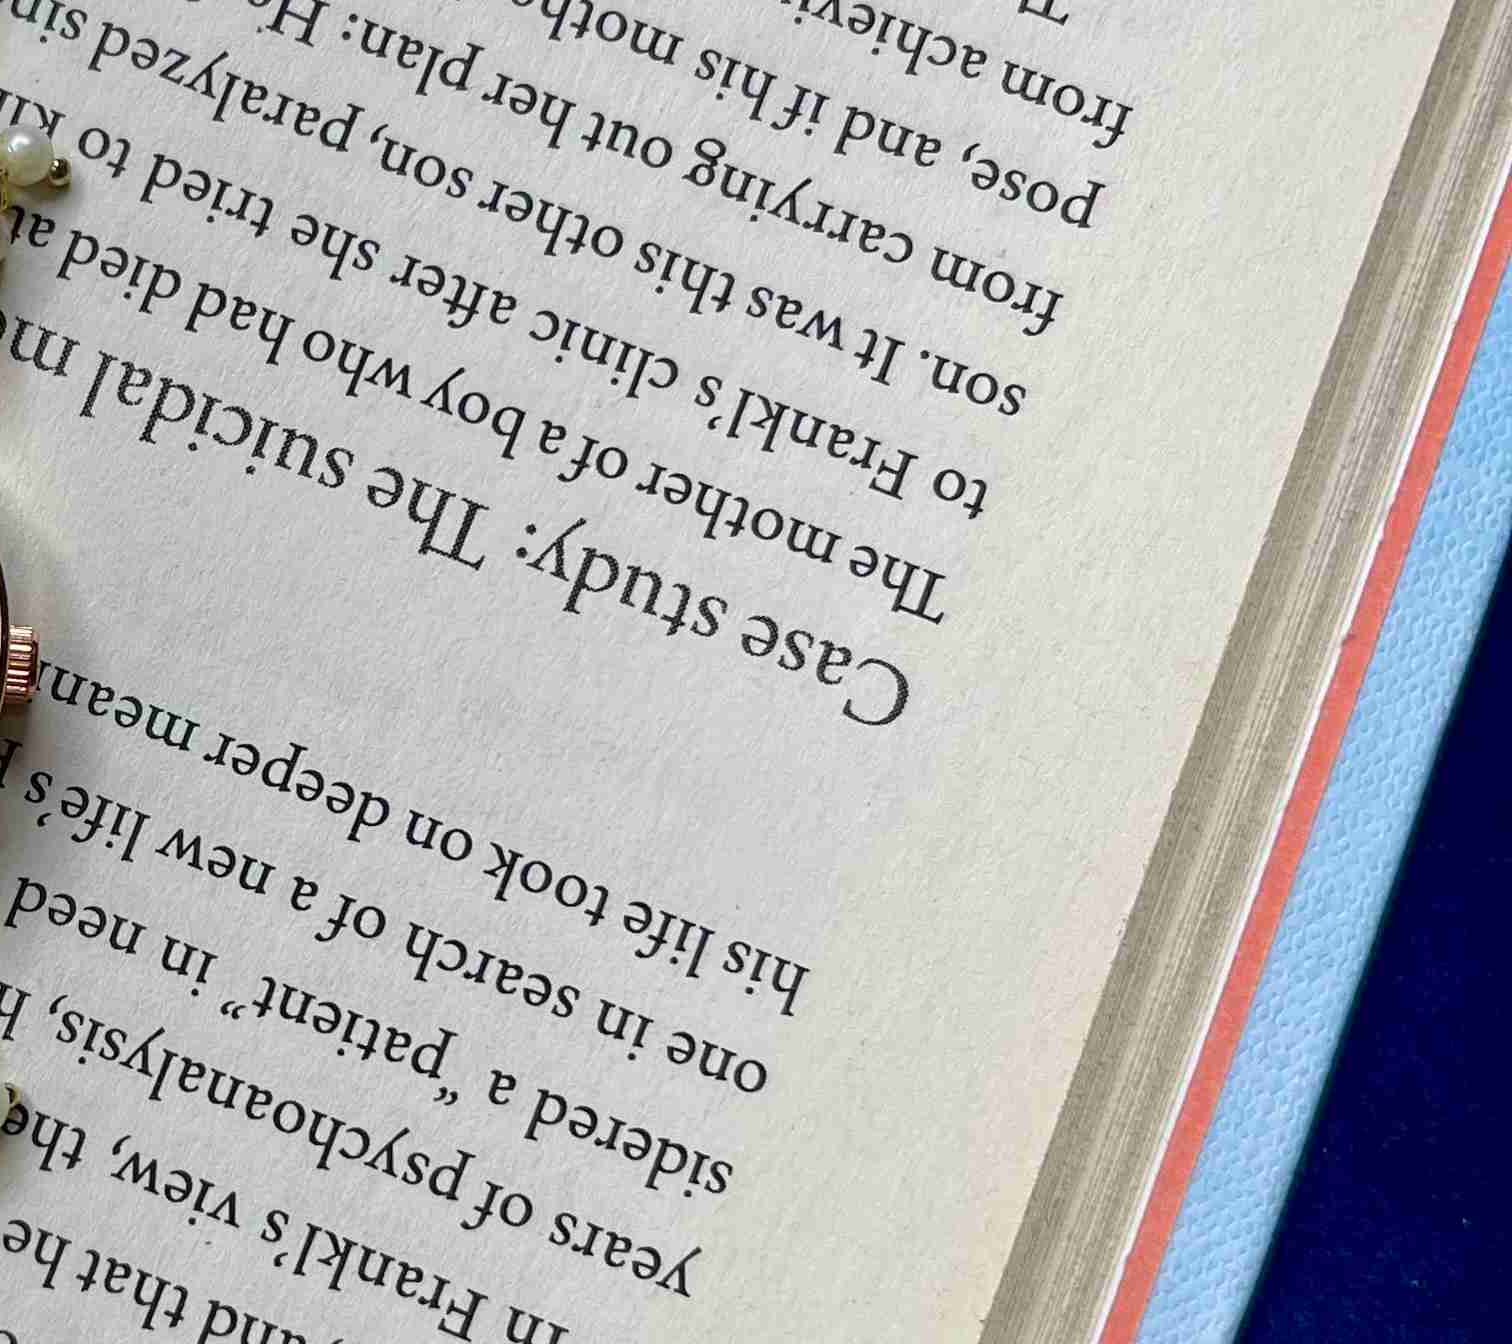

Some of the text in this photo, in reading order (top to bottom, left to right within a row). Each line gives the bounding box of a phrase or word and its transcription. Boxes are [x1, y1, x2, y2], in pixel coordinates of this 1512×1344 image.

[86, 20, 366, 153] paralyzed
[693, 47, 778, 122] his
[768, 82, 831, 137] if
[1000, 59, 1134, 150] from
[368, 122, 474, 199] son,
[832, 104, 942, 168] and
[475, 179, 624, 258] other
[961, 141, 1107, 229] pose,
[632, 240, 736, 315] this
[744, 285, 844, 352] was
[852, 327, 906, 387] It
[5, 202, 946, 625] The mother of a boy who had died at
[918, 348, 1027, 416] son.
[78, 349, 910, 726] Case study: The suicidal
[201, 731, 811, 1017] his life took on deeper
[2, 875, 148, 955] need
[160, 933, 219, 997] in
[487, 1068, 517, 1106] a
[523, 1087, 734, 1198] sidered
[109, 1134, 241, 1246] view,
[1, 1218, 72, 1291] he
[74, 1247, 189, 1331] that
